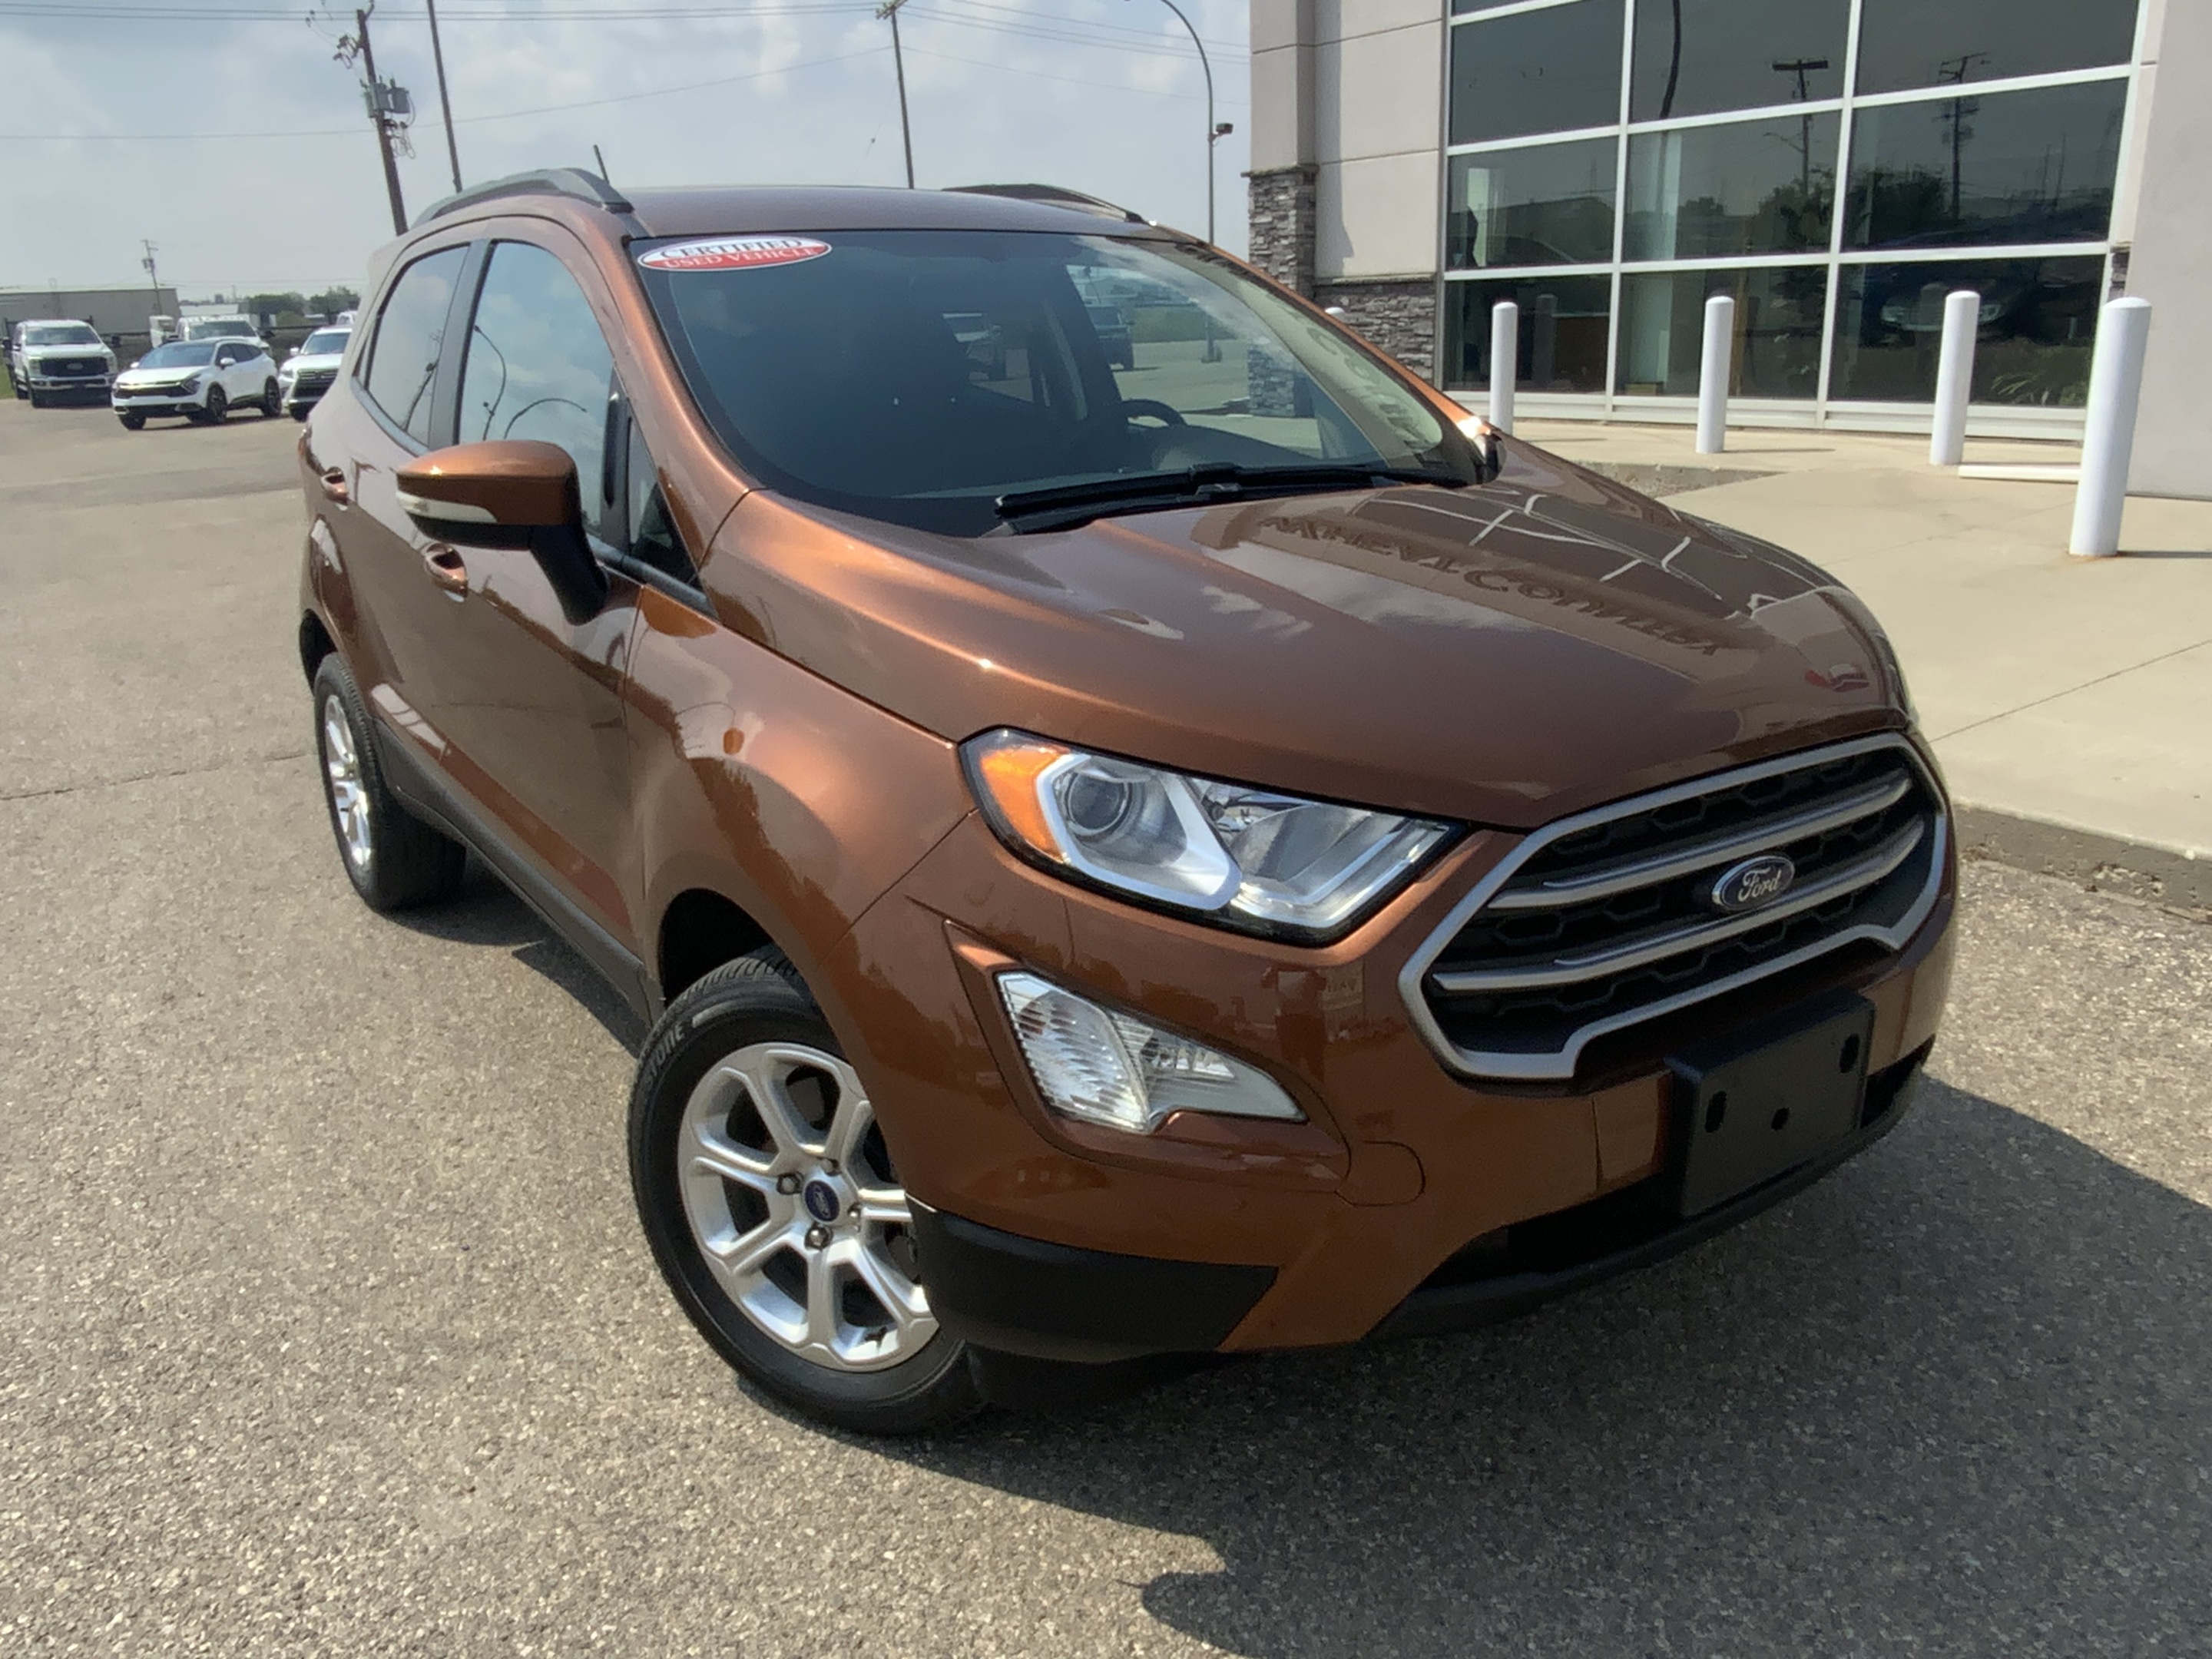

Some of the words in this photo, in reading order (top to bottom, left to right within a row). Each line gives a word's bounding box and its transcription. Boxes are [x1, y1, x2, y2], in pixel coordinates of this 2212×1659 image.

[661, 239, 801, 258] CERTIFIED
[664, 255, 724, 269] USED
[727, 247, 818, 263] VEHICLE
[1737, 866, 1781, 902] Ford
